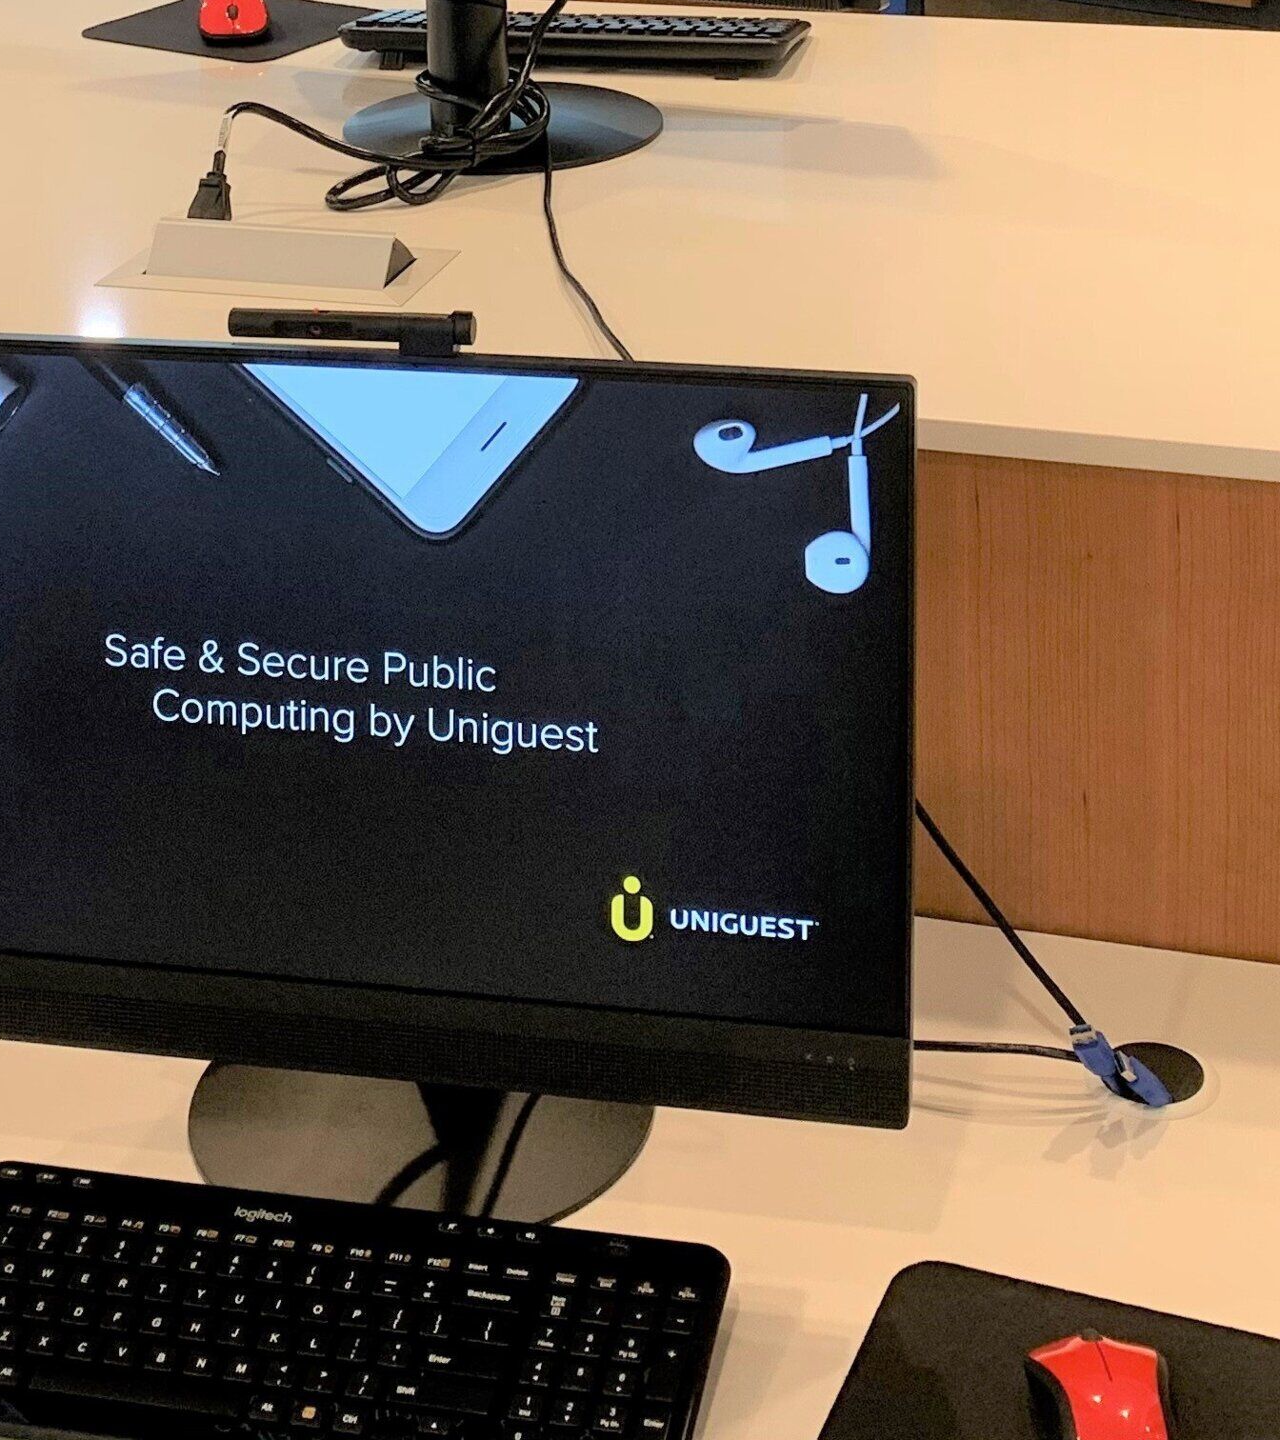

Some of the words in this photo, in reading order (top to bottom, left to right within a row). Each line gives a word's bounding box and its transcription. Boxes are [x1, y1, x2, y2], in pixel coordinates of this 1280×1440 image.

[105, 633, 187, 671] Safe
[198, 639, 225, 673] &
[237, 641, 370, 683] Secure
[383, 651, 497, 692] Public
[152, 688, 355, 743] Computing
[370, 703, 415, 747] by
[428, 707, 599, 755] Uniguest
[670, 908, 814, 941] UNIGUEST
[233, 1206, 293, 1223] logitech
[4, 1263, 15, 1275] Q
[41, 1268, 55, 1278] W
[80, 1273, 91, 1284] E
[118, 1277, 129, 1289] R
[159, 1283, 168, 1294] T
[197, 1288, 207, 1299] Y
[234, 1293, 245, 1305] U
[466, 1288, 511, 1302] Backspace
[35, 1301, 46, 1312] S
[73, 1306, 84, 1317] D
[312, 1304, 324, 1316] O
[112, 1311, 122, 1323] F
[351, 1309, 362, 1319] P
[151, 1317, 162, 1328] G
[189, 1322, 202, 1333] H
[230, 1327, 241, 1338] J
[269, 1332, 281, 1344] K
[37, 1336, 49, 1347] X
[77, 1341, 88, 1353] C
[309, 1337, 318, 1349] L
[118, 1346, 128, 1357] V
[155, 1352, 167, 1363] B
[195, 1358, 208, 1369] N
[428, 1353, 452, 1365] Enter
[235, 1362, 248, 1374] M
[341, 1413, 359, 1425] Ctrl
